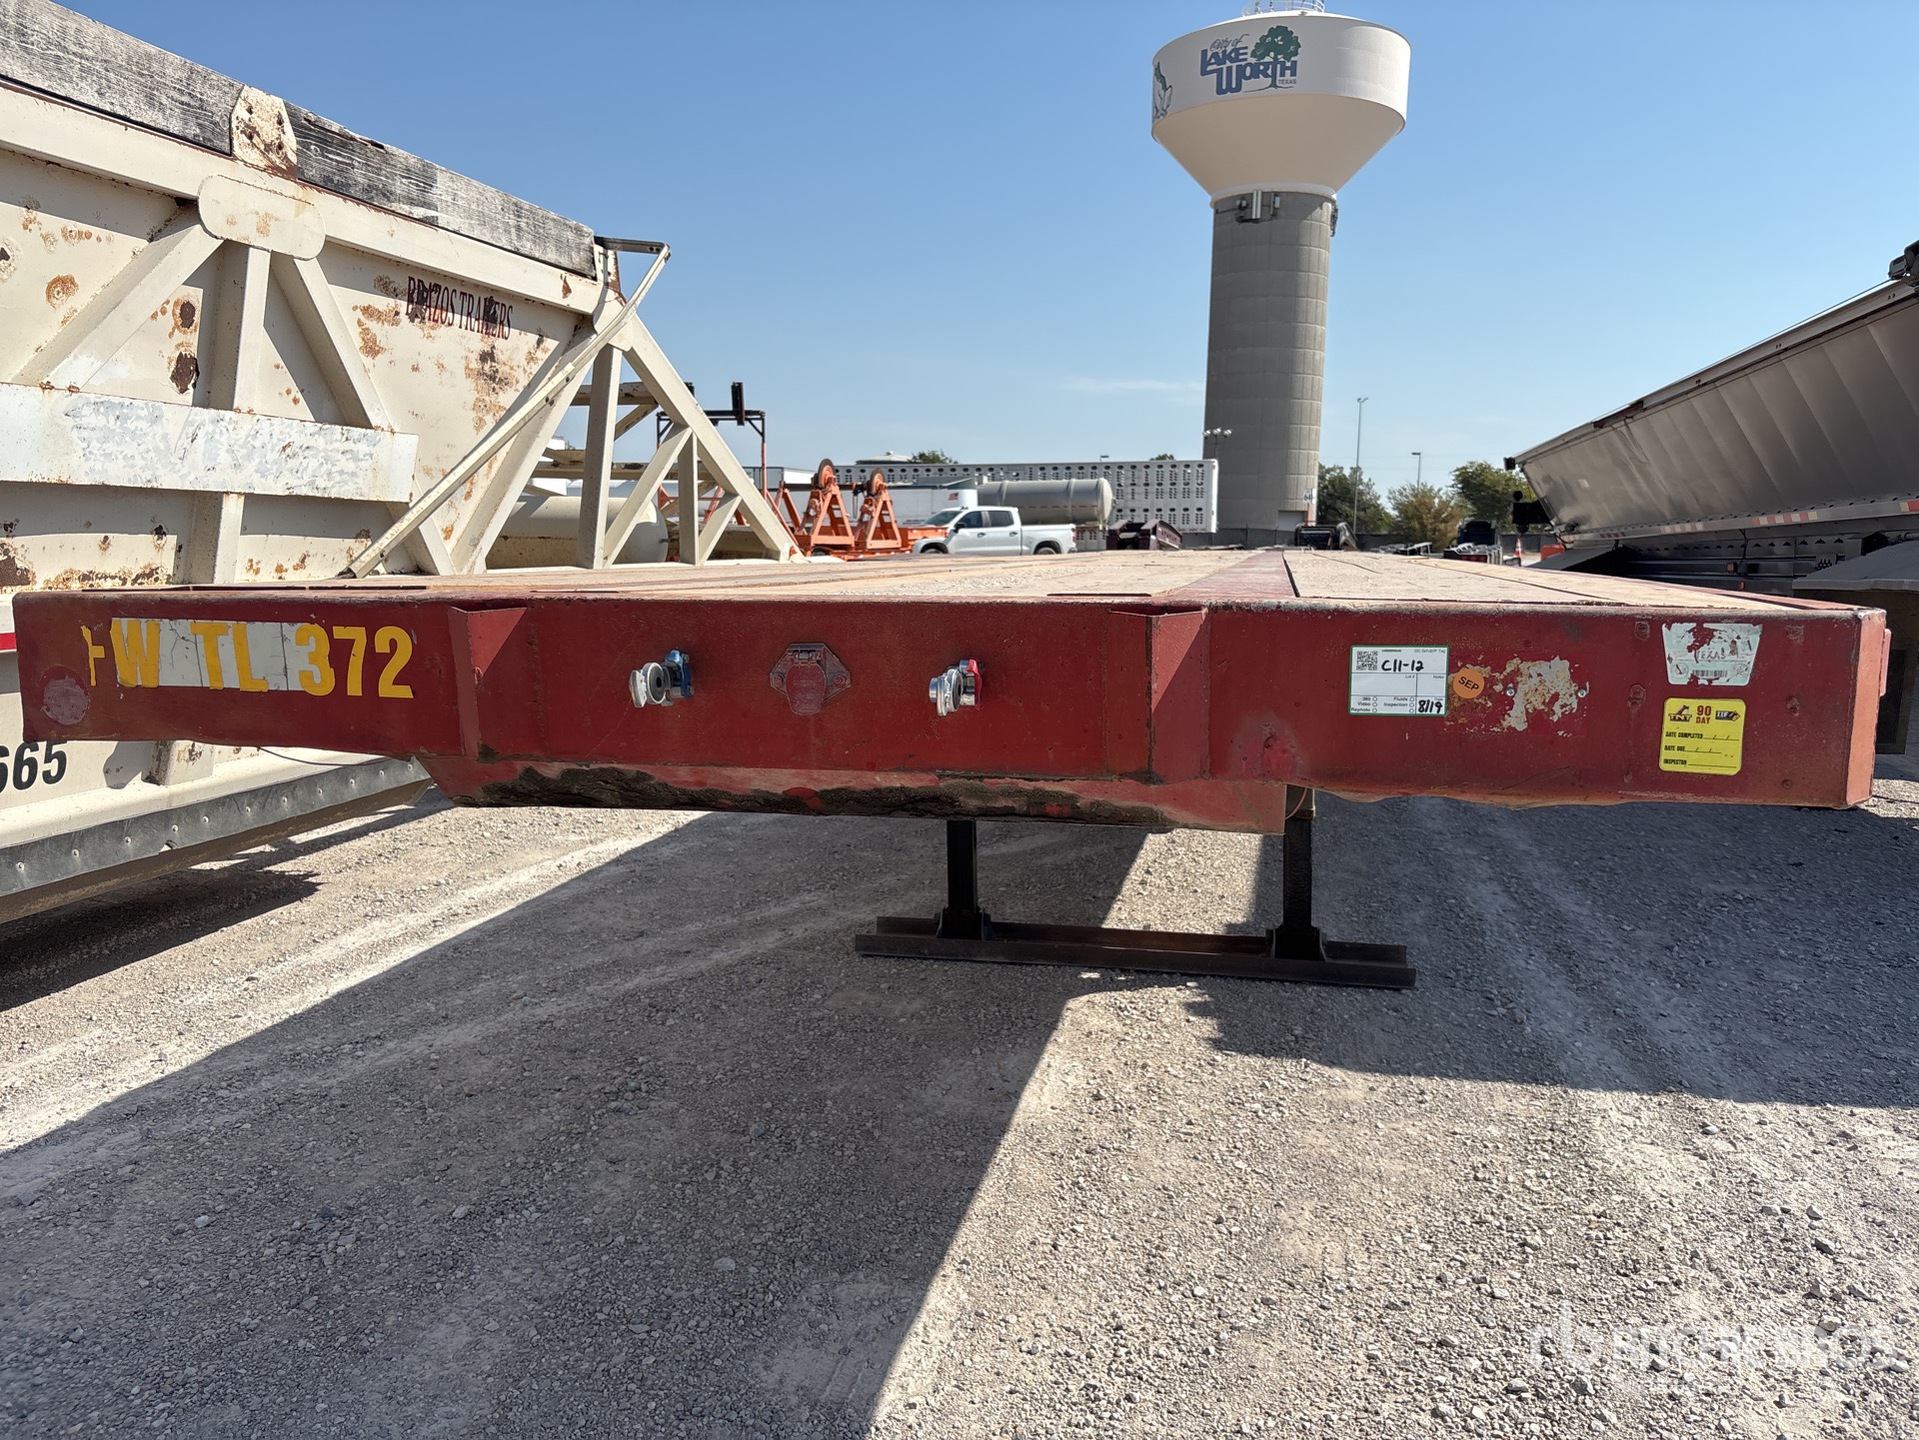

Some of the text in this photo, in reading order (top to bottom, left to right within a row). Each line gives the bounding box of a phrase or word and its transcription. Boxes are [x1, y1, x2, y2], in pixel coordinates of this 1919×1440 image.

[1210, 33, 1249, 51] City of
[1201, 46, 1248, 76] LAKE
[1216, 60, 1298, 95] WORTH
[295, 622, 414, 699] 372
[1458, 676, 1480, 690] SEP
[1697, 705, 1712, 717] 90
[1696, 716, 1711, 724] DAY
[1663, 758, 1687, 766] INSPECTOR
